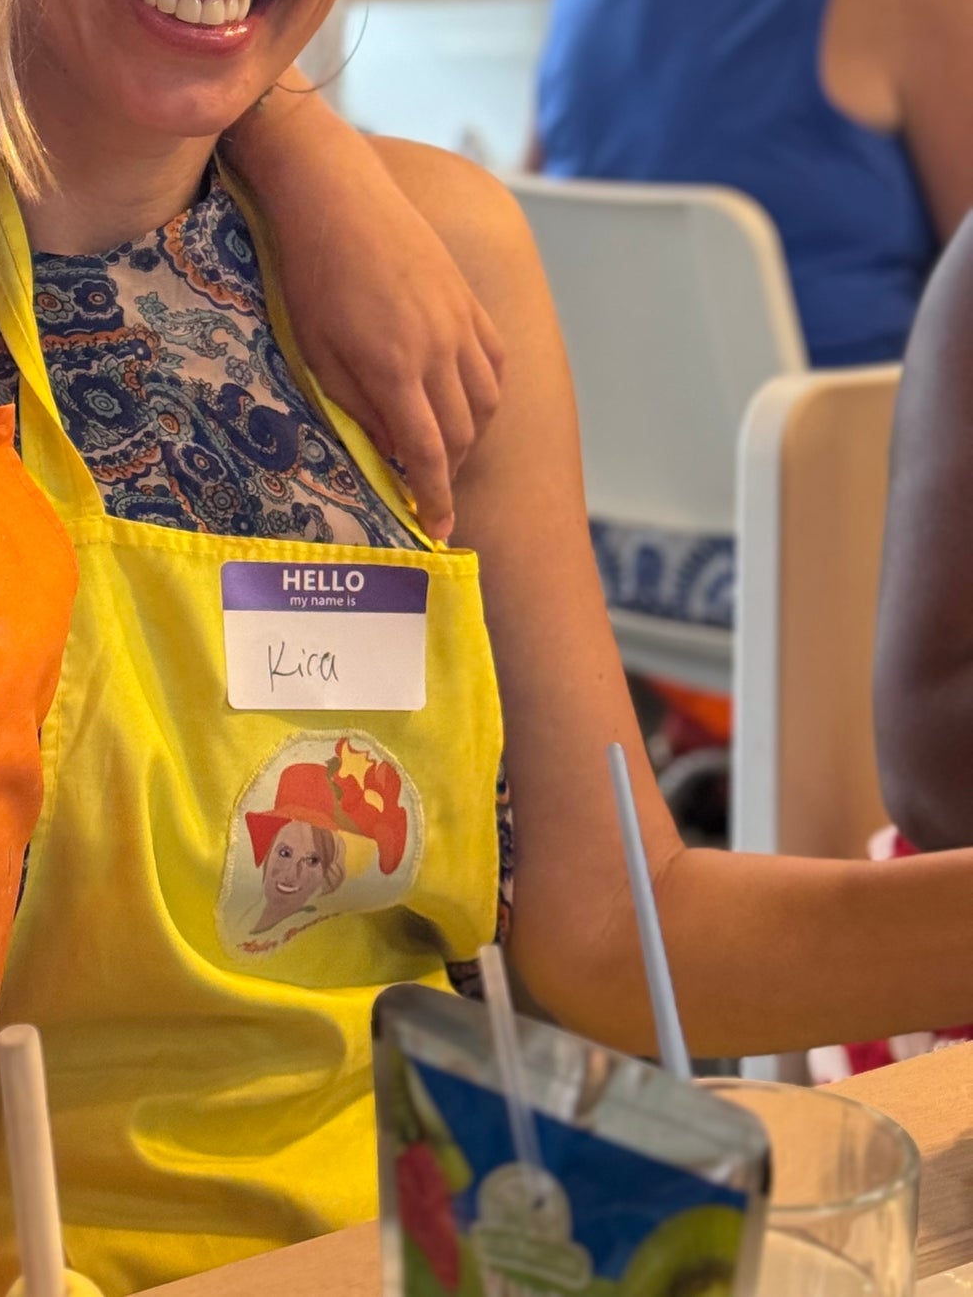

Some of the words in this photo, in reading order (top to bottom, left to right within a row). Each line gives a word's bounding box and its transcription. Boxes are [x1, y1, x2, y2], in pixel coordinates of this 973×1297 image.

[282, 569, 365, 592] HELLO
[290, 596, 308, 608] my
[311, 596, 344, 607] name
[347, 595, 356, 607] is
[268, 641, 339, 692] Kira
